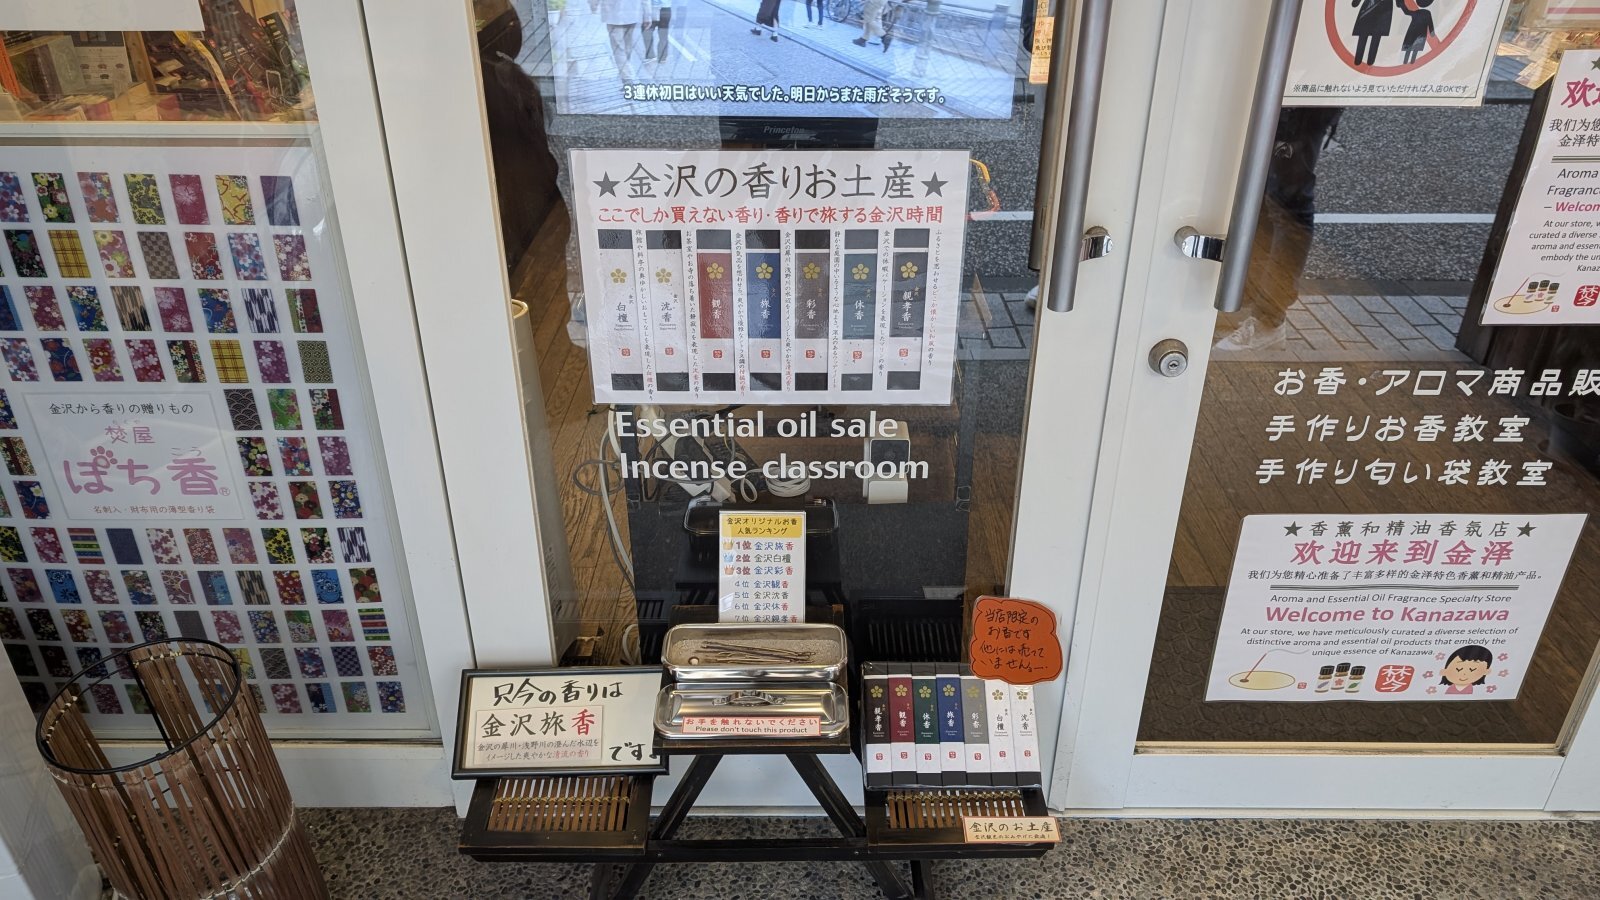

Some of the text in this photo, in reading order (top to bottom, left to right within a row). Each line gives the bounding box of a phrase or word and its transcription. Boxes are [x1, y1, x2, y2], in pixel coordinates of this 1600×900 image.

[623, 83, 946, 104] 3連休初日はいい天気でした。明日からまた雨だそうです。
[1560, 77, 1600, 108] 欢
[763, 125, 806, 134] Princeton
[1557, 168, 1599, 179] Aroma
[623, 162, 916, 200] 金沢の香りお土産
[1546, 186, 1600, 198] Fragranc
[597, 205, 943, 225] ここでしか買えない香り・香りで旅する金沢時間
[1568, 231, 1598, 239] diverse
[1559, 242, 1576, 250] and
[1540, 253, 1574, 263] embody
[616, 302, 629, 323] 白檀
[661, 302, 672, 322] 沈香
[1273, 367, 1600, 397] お香・アロマ商品販
[49, 403, 193, 415] 金沢から香りの贈りもの
[615, 410, 898, 438] Essential oil sale
[1265, 414, 1530, 443] 手作りお香教室
[620, 453, 929, 480] Incense classroom
[1256, 457, 1553, 486] 手作り匂い袋教室
[726, 517, 797, 525] 金沢オリジナルお香
[737, 527, 788, 535] 人気ランキング
[1290, 539, 1514, 566] 欢迎来到金泽
[734, 580, 749, 589] 4位
[734, 591, 749, 599] 5位
[1270, 593, 1511, 604] Aroma and Essential Oil Fragrance Specialty Store
[734, 602, 749, 610] 6位
[985, 608, 1039, 626] 当店限定の
[1266, 606, 1510, 623] Welcome to Kanazawa
[987, 626, 1032, 640] お香です
[1335, 627, 1389, 636] meticulously
[1391, 628, 1426, 636] curated
[1467, 627, 1507, 635] selection
[1508, 626, 1520, 635] of
[1246, 638, 1291, 646] distinctive
[1393, 638, 1432, 647] products
[1434, 637, 1452, 645] that
[1453, 638, 1489, 647] embody
[1311, 649, 1341, 657] unique
[493, 678, 624, 706] 只今の香りは
[481, 708, 595, 738] 金沢旅香
[686, 718, 818, 726] お手を触れないでください
[969, 821, 1054, 833] 金沢のお土産
